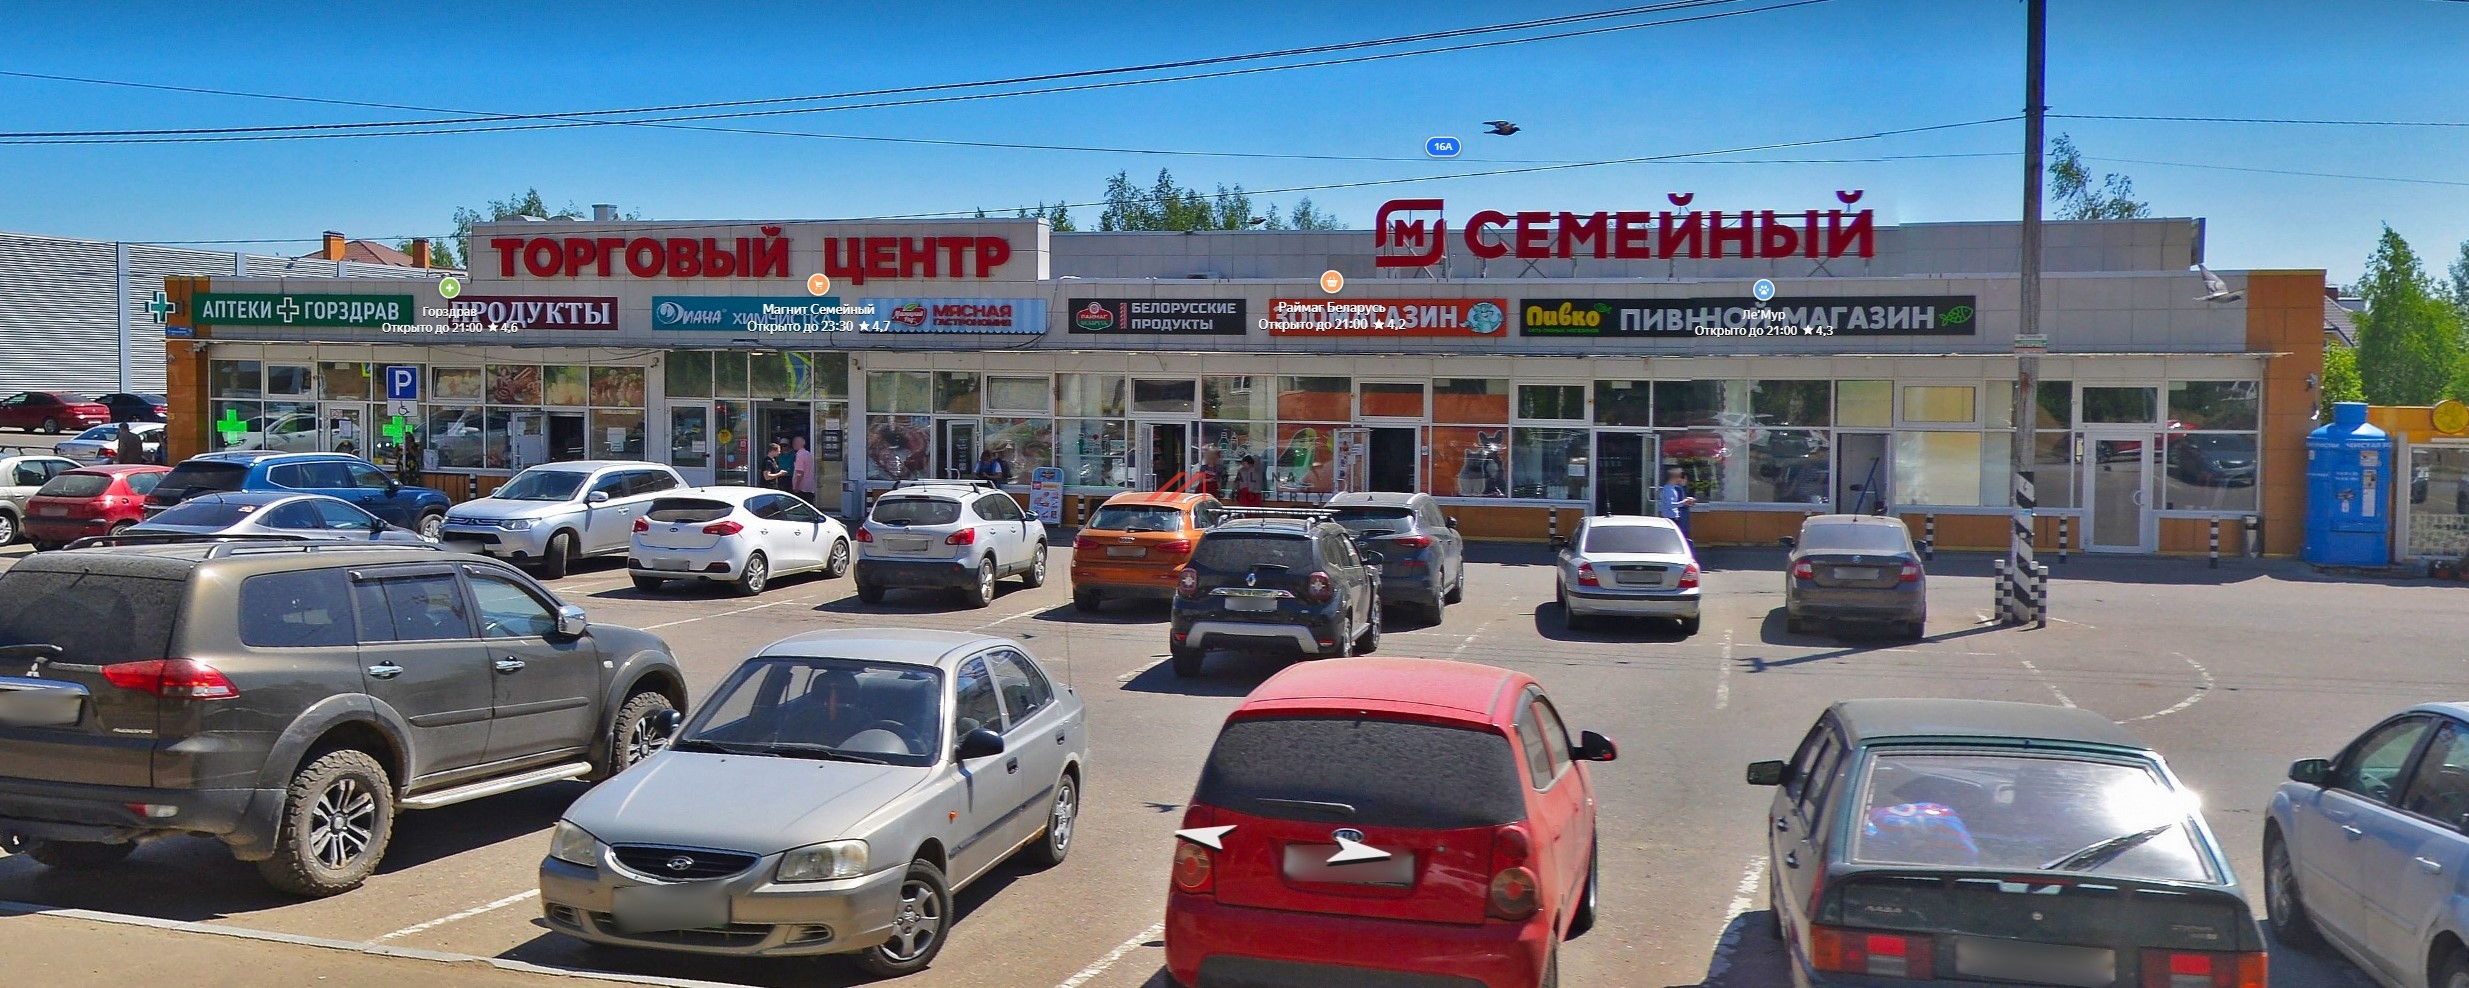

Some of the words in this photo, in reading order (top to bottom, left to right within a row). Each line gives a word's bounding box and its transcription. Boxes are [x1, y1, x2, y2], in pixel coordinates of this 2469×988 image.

[1463, 189, 1875, 260] СЕМЕЙНЫЙ
[490, 225, 789, 278] ТОРГОВЫЙ
[823, 236, 1011, 286] ЦЕНТР
[202, 300, 272, 319] АПТЕКИ
[304, 301, 400, 324] ГОРЗДРАВ
[450, 301, 611, 328] ПРОДУКТЫ
[932, 304, 1012, 317] МЯСНАЯ
[1131, 302, 1237, 314] БЕЛОРУССКИЕ
[1526, 301, 1600, 327] Пивко
[1783, 305, 1935, 330] МАГАЗИН
[1131, 318, 1213, 331] ПРОДУКТЫ
[395, 370, 412, 396] P
